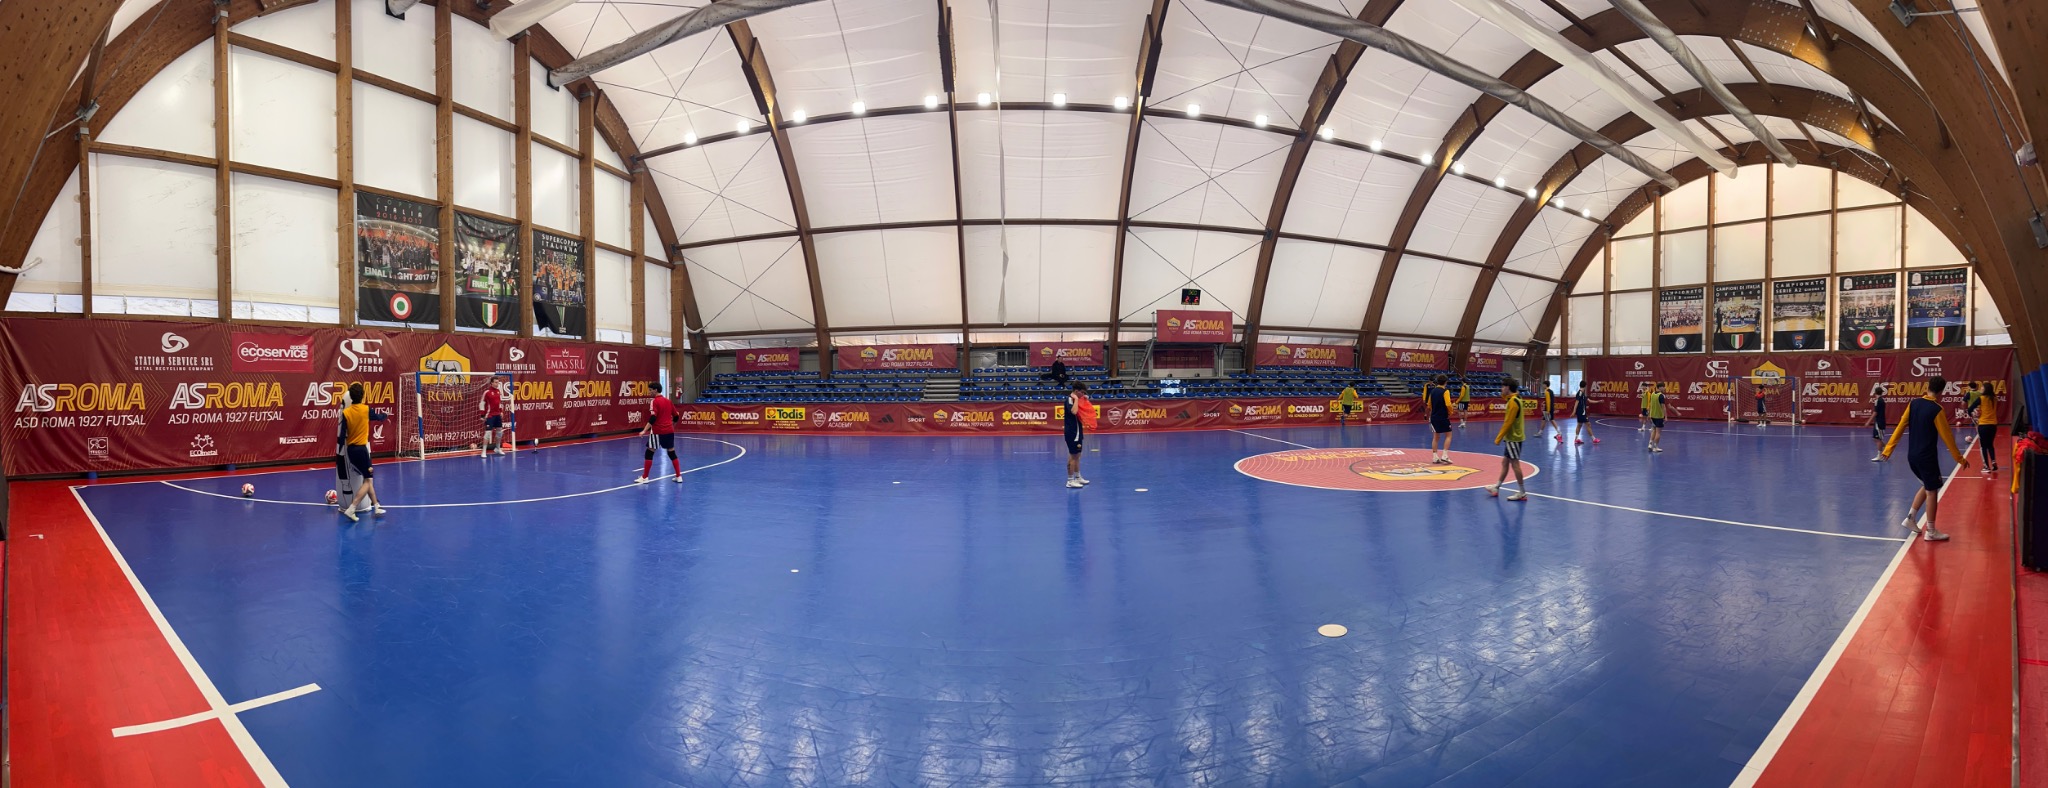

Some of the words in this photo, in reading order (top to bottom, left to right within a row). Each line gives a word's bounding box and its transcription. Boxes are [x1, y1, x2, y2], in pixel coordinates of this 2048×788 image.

[376, 204, 423, 218] ITALIA
[541, 233, 578, 247] SUPERCOPPA
[541, 241, 578, 253] ITALIANA
[364, 266, 388, 278] FINAL
[414, 273, 430, 281] 2017
[1775, 279, 1825, 288] CAMPIONATO
[1661, 288, 1702, 296] CAMPIONATO
[1184, 319, 1224, 330] ASROMA
[241, 347, 308, 358] ecoservice
[757, 353, 789, 363] ASROMA
[881, 348, 933, 361] ASROMA
[1293, 347, 1337, 359] ASROMA
[1400, 351, 1435, 363] ASROMA
[134, 356, 165, 366] STATION
[168, 357, 198, 366] SERVICE
[201, 357, 214, 366] SRL
[546, 359, 568, 370] EMAS
[570, 359, 585, 370] SRL
[563, 381, 612, 399] ASROMA
[1590, 381, 1629, 393] ASROMA
[1802, 382, 1859, 396] ASROMA
[15, 383, 146, 413] ASROMA
[169, 382, 284, 410] ASROMA
[428, 390, 463, 402] ROMA
[522, 402, 535, 411] 1927
[535, 402, 554, 410] FUTSAL
[1245, 405, 1282, 416] ASROMA
[1295, 405, 1324, 413] CONAD
[1381, 403, 1411, 412] ASROMA
[168, 414, 190, 424] ASD
[192, 413, 223, 424] ROMA
[225, 412, 248, 422] 1927
[249, 411, 284, 422] FUTSAL
[302, 410, 318, 420] ASD
[682, 411, 716, 421] ASROMA
[730, 412, 760, 420] CONAD
[776, 409, 803, 420] Todis
[828, 411, 870, 422] ASROMA
[951, 411, 995, 422] ASROMA
[1011, 411, 1047, 420] CONAD
[1125, 408, 1167, 419] ASROMA
[14, 417, 38, 428] ASD
[41, 416, 76, 428] ROMA
[79, 415, 104, 427] 1927
[105, 414, 146, 426] FUTSAL
[425, 433, 443, 442] ROMA
[444, 432, 460, 441] 1927
